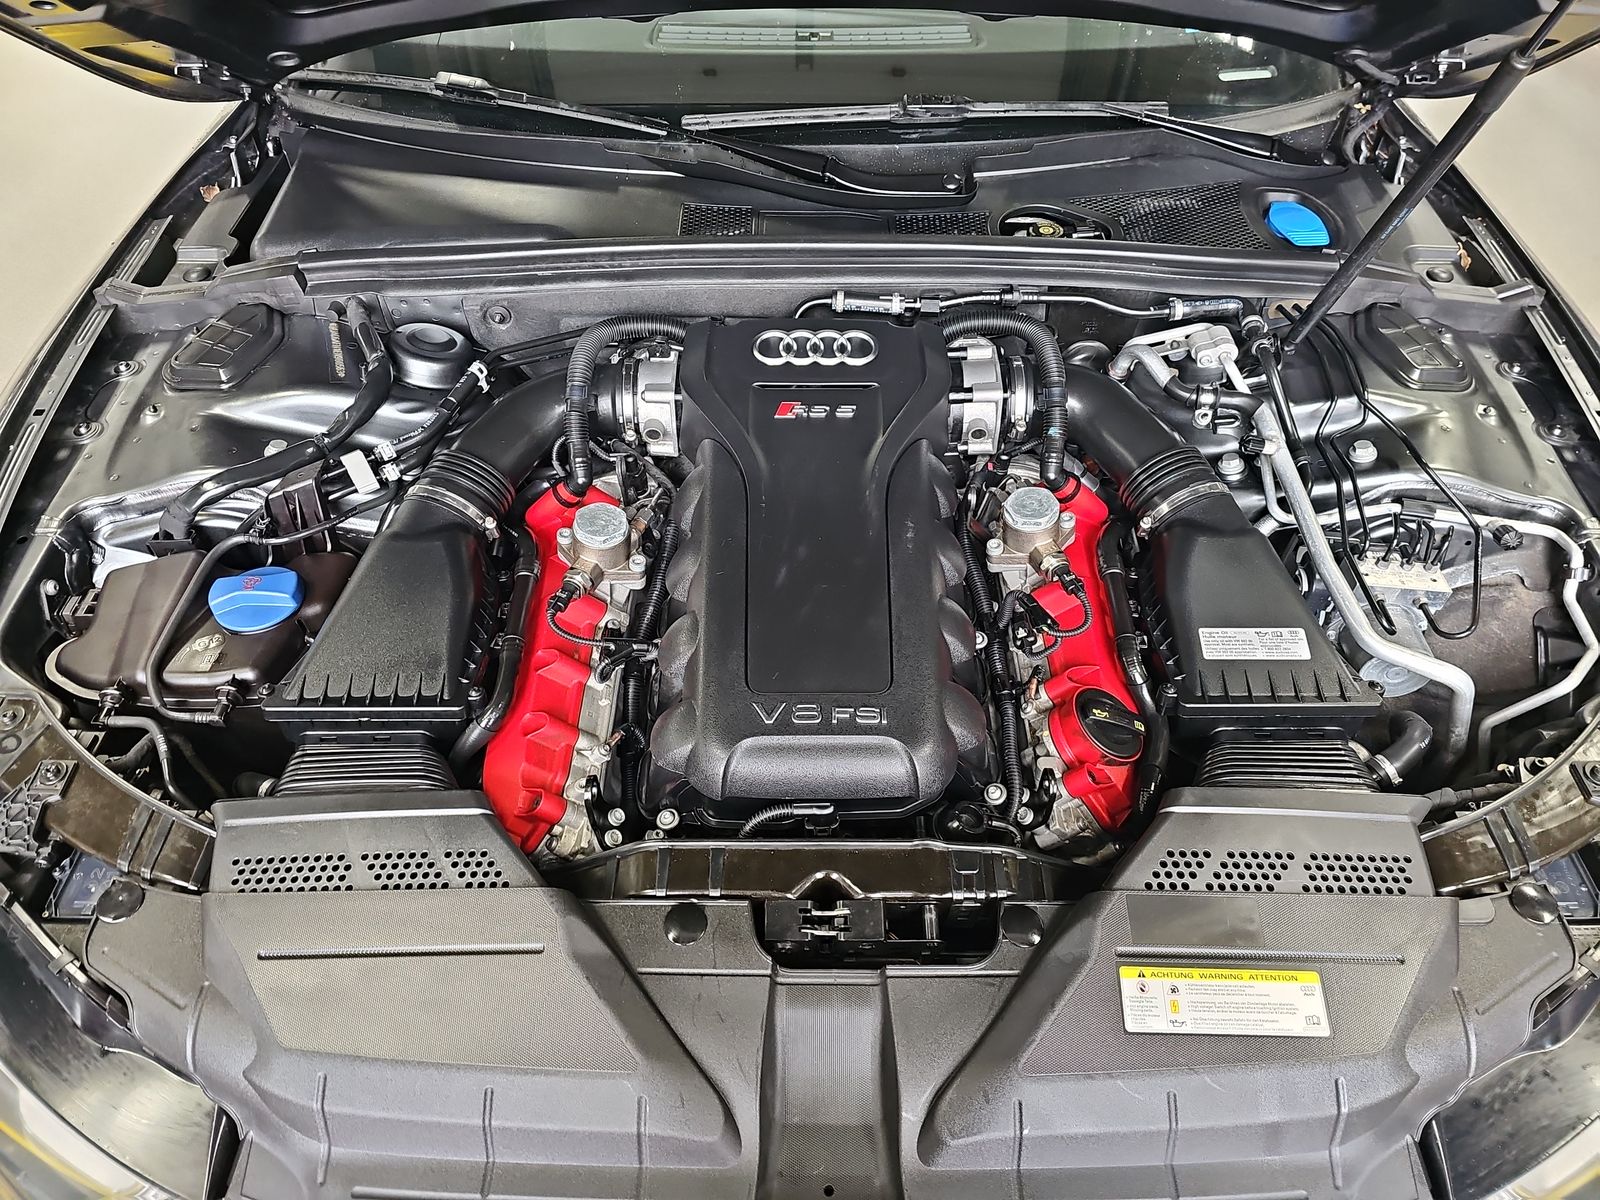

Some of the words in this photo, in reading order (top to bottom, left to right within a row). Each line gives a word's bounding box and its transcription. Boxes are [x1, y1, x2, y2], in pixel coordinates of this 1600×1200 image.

[752, 702, 822, 724] V8
[831, 706, 888, 724] FSI
[1150, 971, 1194, 979] ACHTUNG
[1199, 972, 1244, 981] WARNING
[1248, 973, 1298, 982] ATTENTION
